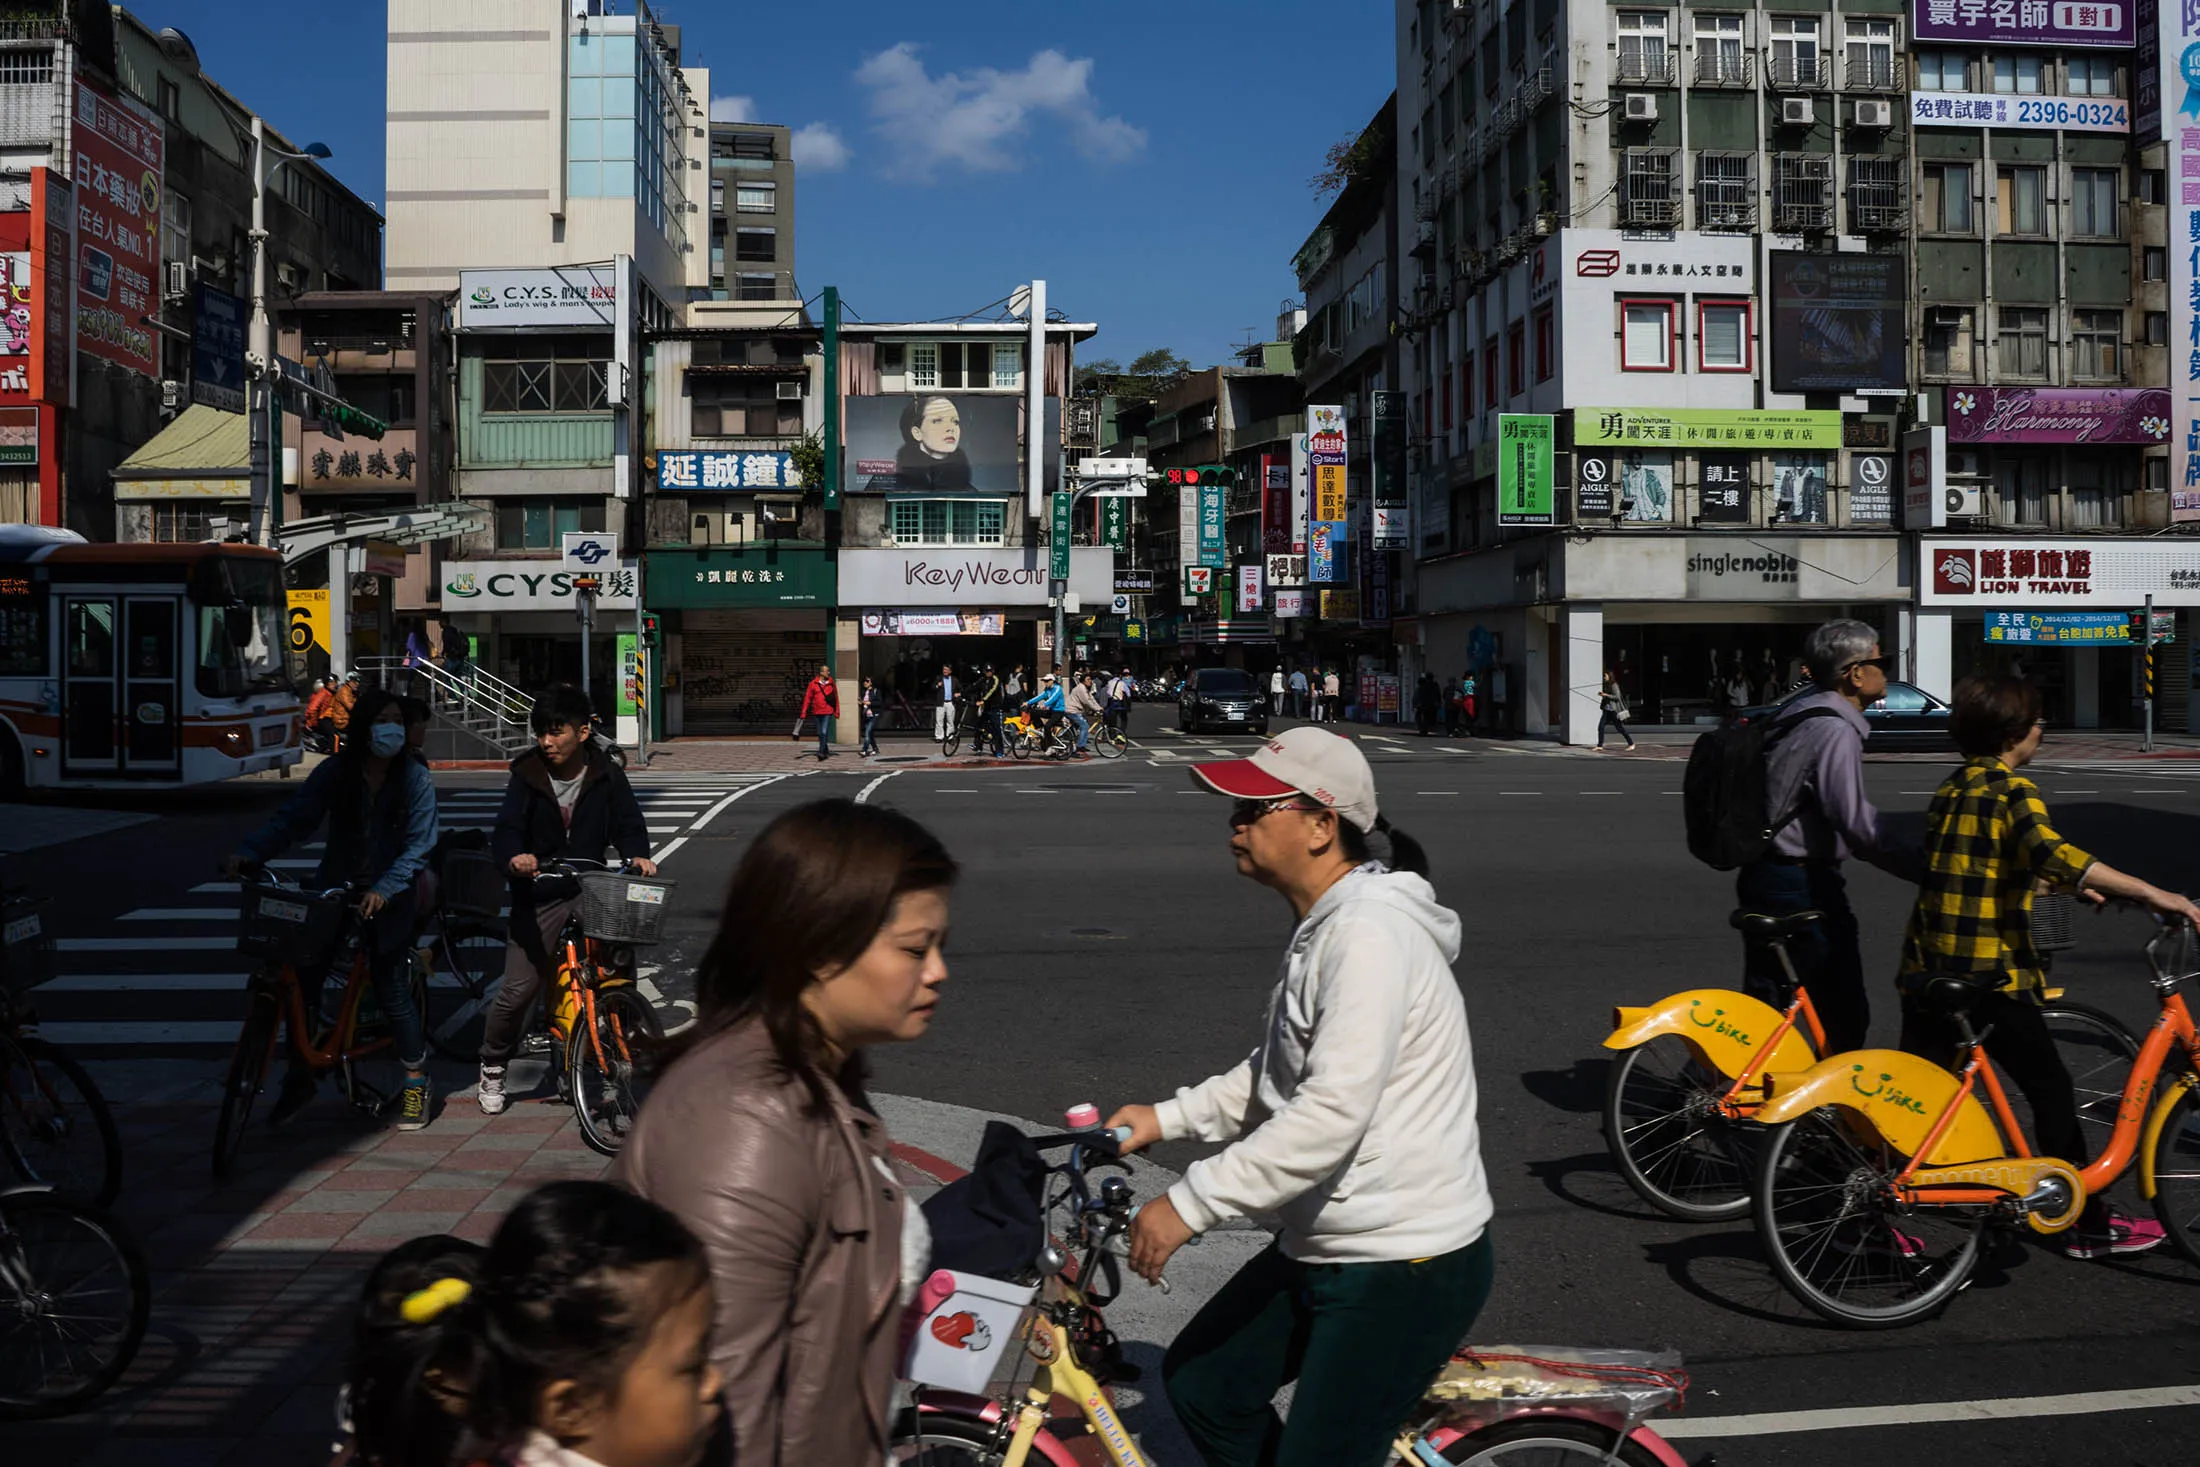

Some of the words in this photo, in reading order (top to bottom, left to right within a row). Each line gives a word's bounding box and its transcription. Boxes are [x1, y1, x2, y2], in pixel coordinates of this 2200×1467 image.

[2062, 6, 2113, 28] 1對1
[1915, 98, 1993, 121] 免費試聽
[2018, 100, 2129, 126] 2396-0324
[504, 286, 558, 300] C.Y.S.
[532, 301, 548, 310] wig
[1600, 412, 1624, 440] 勇
[1984, 399, 2102, 443] Harmony
[1167, 469, 1182, 483] 98
[1706, 465, 1740, 483] 請上
[1579, 484, 1610, 492] AIGLE
[1859, 485, 1888, 494] AIGLE
[1707, 489, 1740, 507] 二樓
[487, 573, 573, 598] CYS
[1980, 581, 2020, 595] LION
[2028, 581, 2092, 595] TRAVEL
[1997, 612, 2025, 627] 全民
